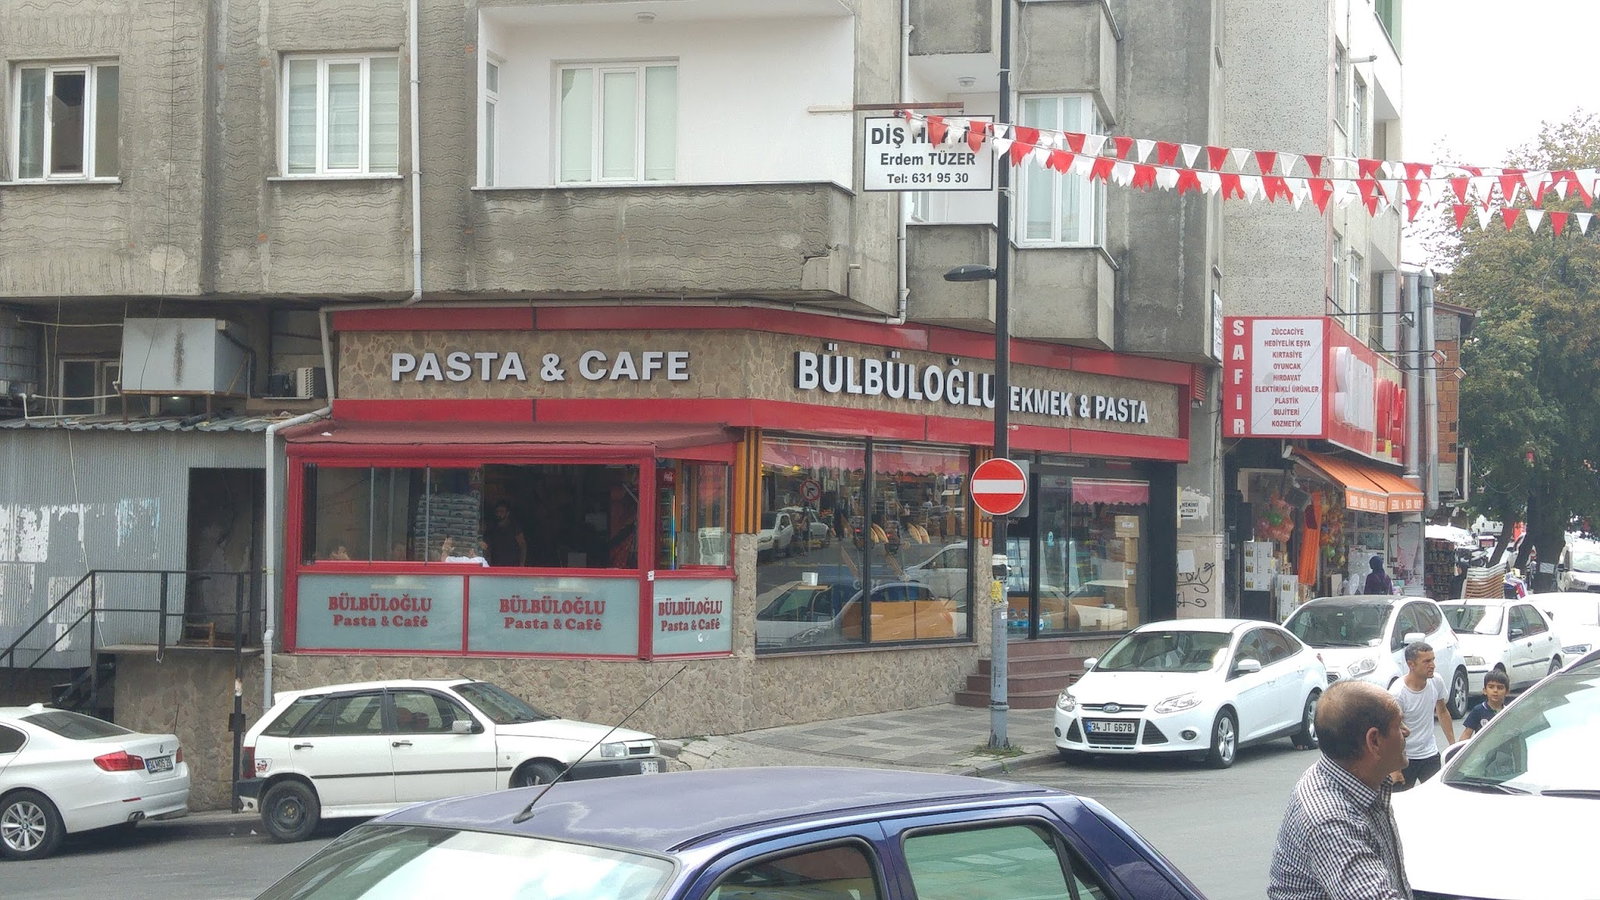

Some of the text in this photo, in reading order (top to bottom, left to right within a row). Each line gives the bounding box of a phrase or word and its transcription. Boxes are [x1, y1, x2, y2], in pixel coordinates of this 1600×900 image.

[871, 123, 905, 149] DİŞ
[880, 150, 976, 165] Erdem TÜZER
[887, 172, 969, 184] Tel: 631 95 30
[1264, 339, 1311, 348] HEDİYELİK EŞYA
[1272, 350, 1303, 359] KIRTASİYE
[391, 350, 690, 382] PASTA & CAFE
[797, 342, 1149, 424] BÜLBÜLOĞLU EKMEK & PASTA
[1291, 384, 1319, 393] ÜRÜNLER
[1274, 396, 1299, 404] PLASTİK
[1273, 408, 1300, 416] BUJİTERİ
[1271, 419, 1302, 427] KOZMETİK
[328, 592, 432, 612] BÜLBÜLOĞLU
[499, 595, 607, 615] BÜLBÜLOĞLU
[658, 597, 723, 616] BÜLBÜLOĞLU
[333, 614, 429, 628] Pasta & Café
[503, 616, 603, 631] Pasta & Café
[661, 618, 721, 632] Pasta & Café
[1091, 722, 1132, 732] 34 JT 6678
